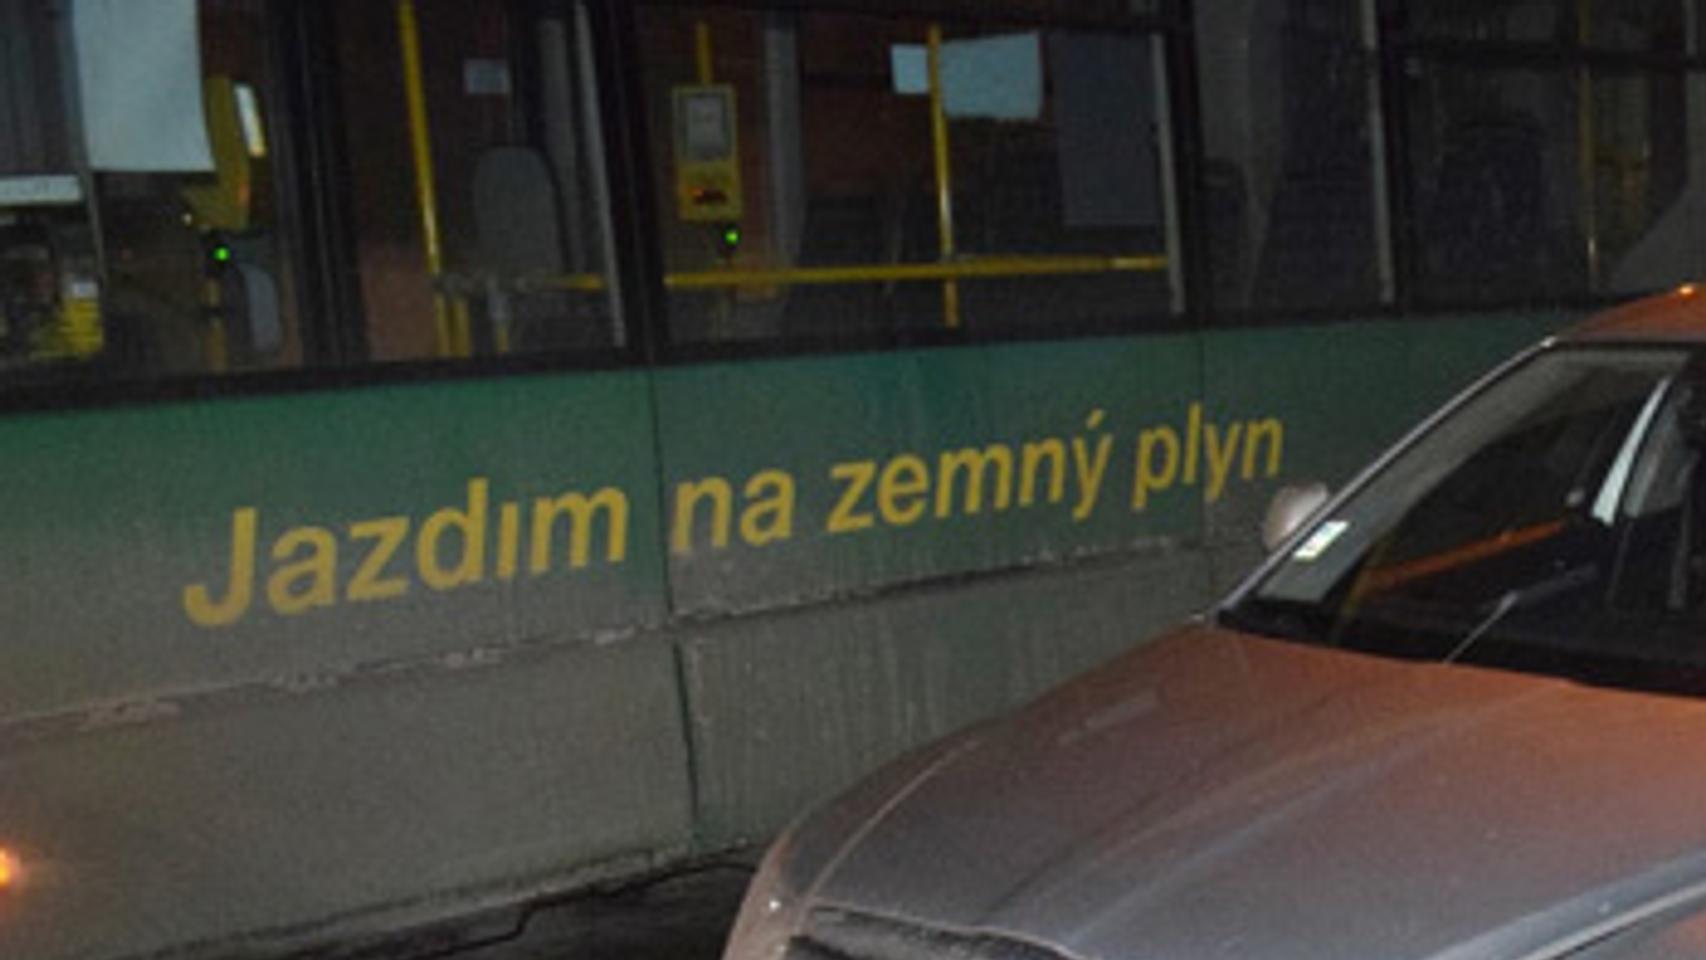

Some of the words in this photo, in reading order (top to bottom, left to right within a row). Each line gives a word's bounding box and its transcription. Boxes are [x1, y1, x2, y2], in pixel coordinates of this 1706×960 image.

[671, 469, 797, 554] na
[827, 409, 1112, 534] zemný
[1131, 402, 1285, 511] plyn
